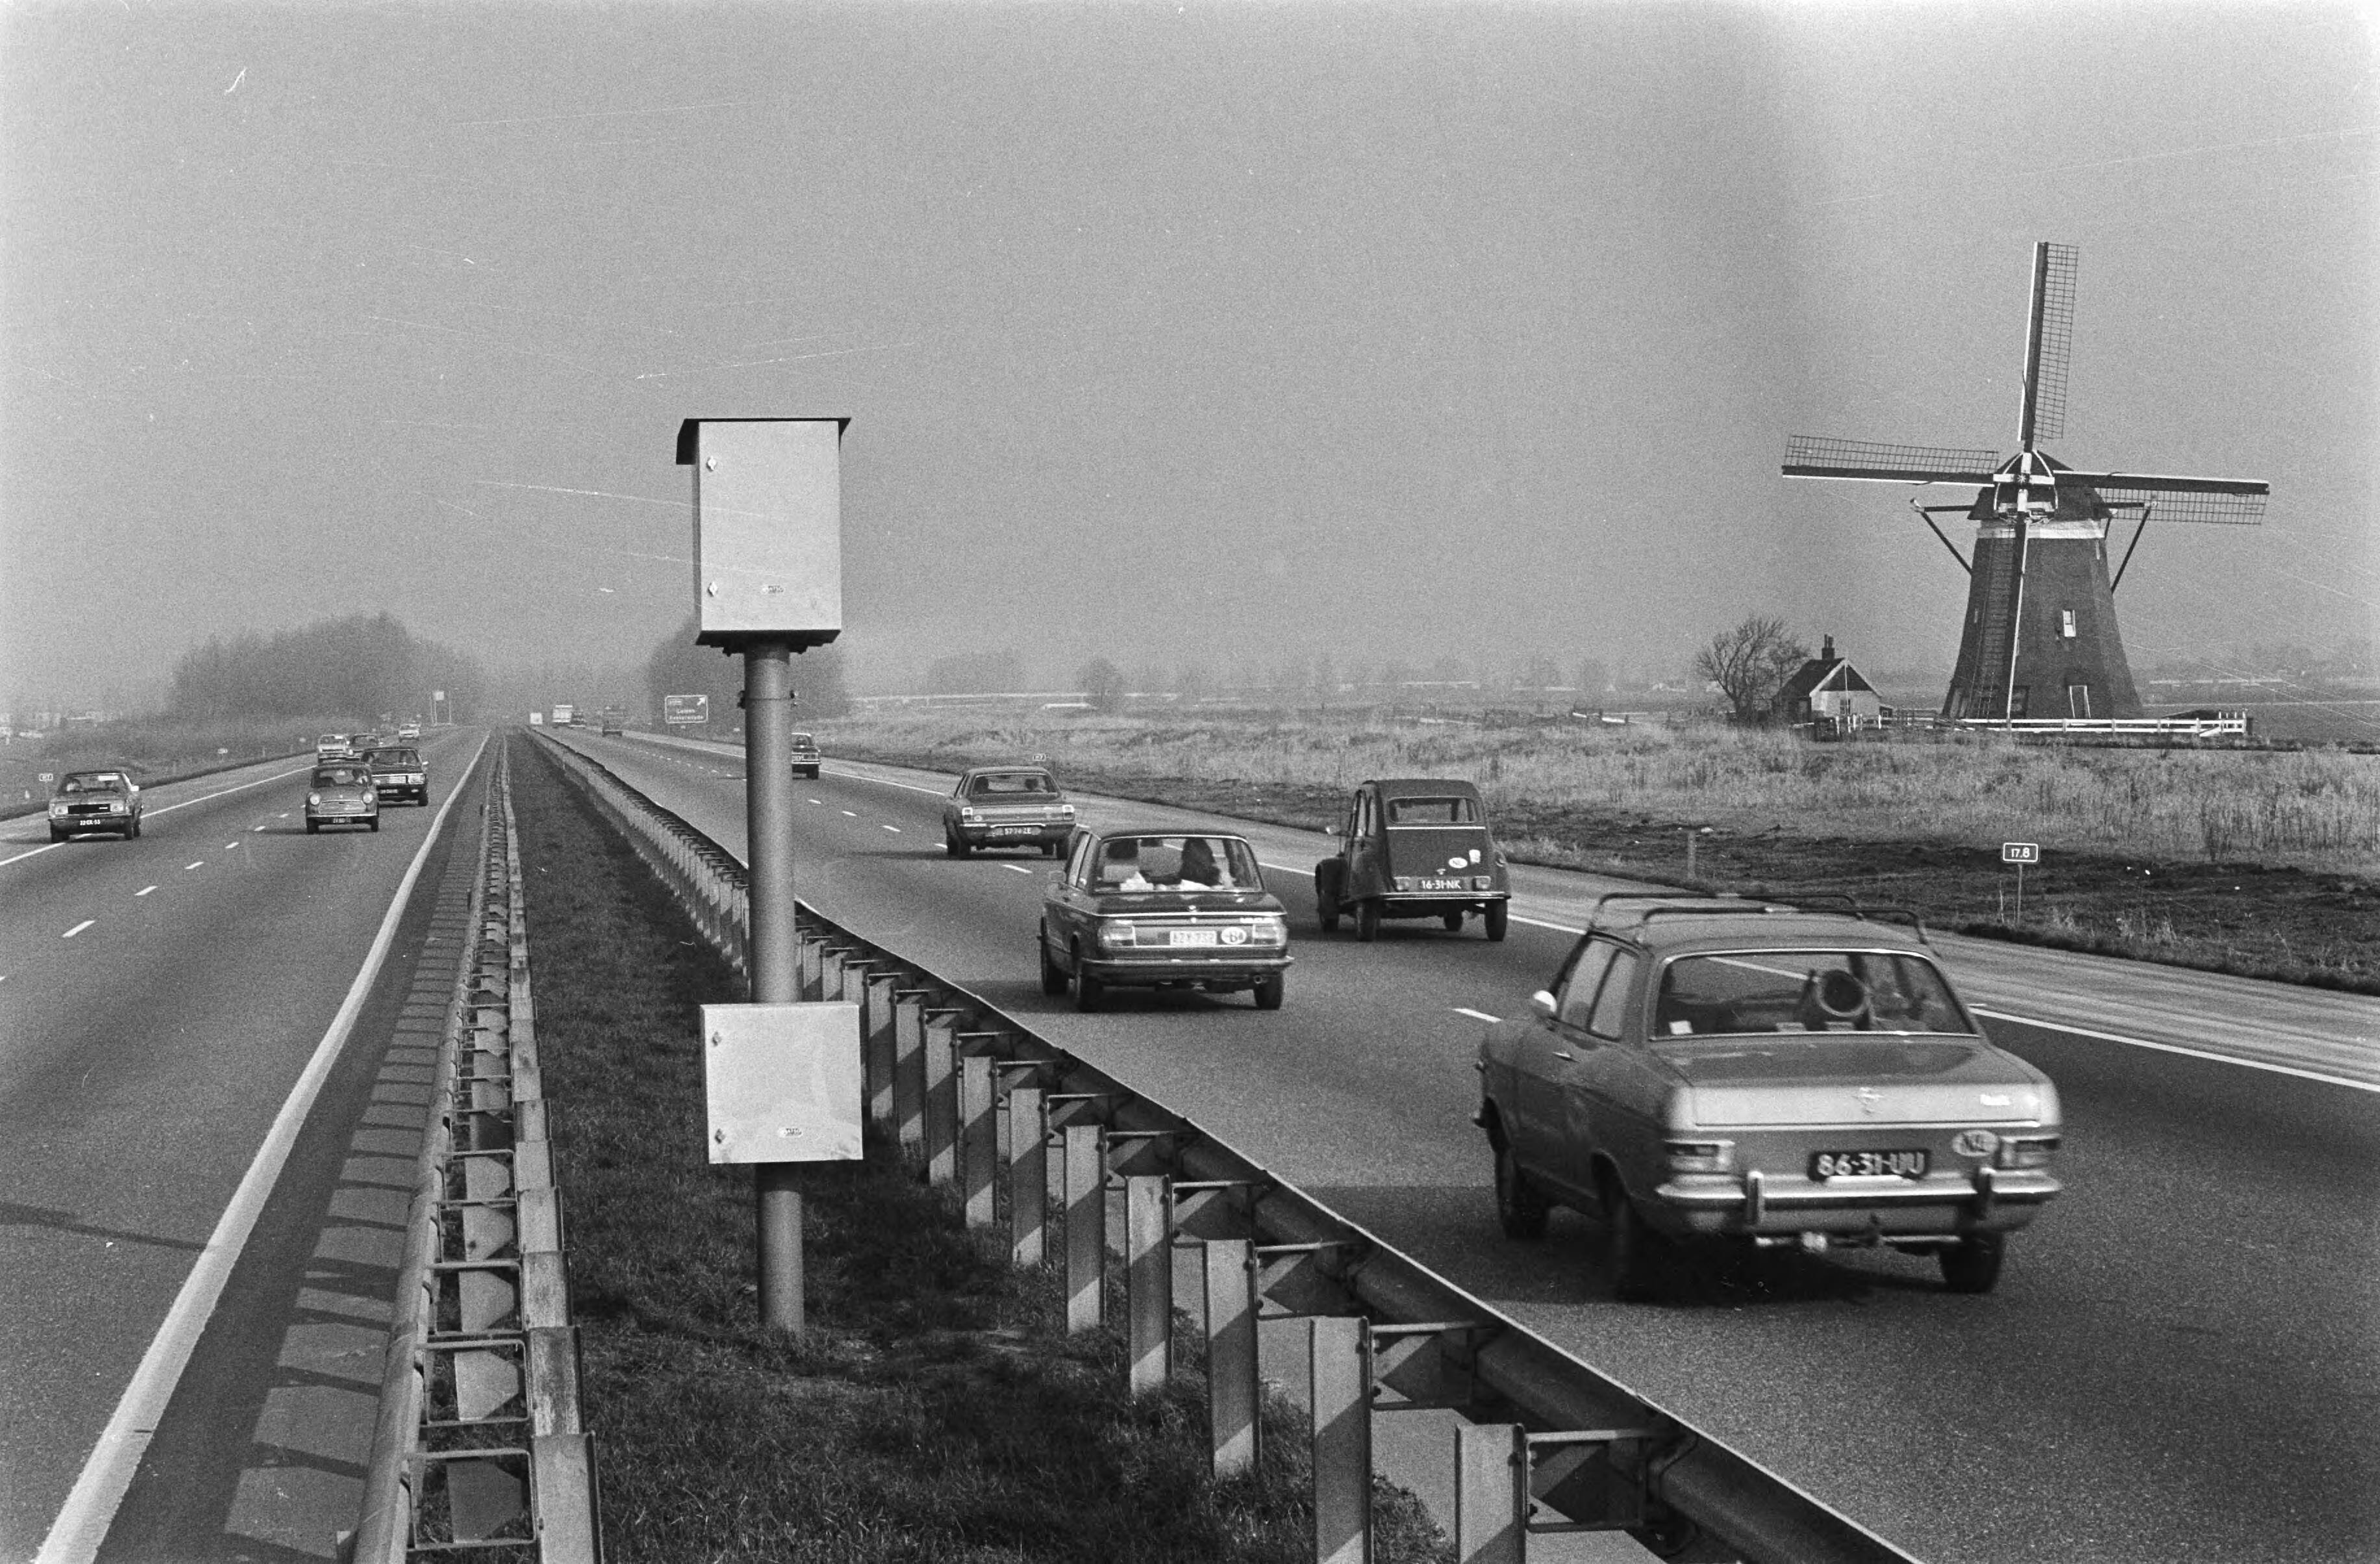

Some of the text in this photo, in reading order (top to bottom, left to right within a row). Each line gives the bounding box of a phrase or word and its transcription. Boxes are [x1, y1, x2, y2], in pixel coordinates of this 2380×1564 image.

[2011, 847, 2030, 858] 17.8
[1421, 880, 1462, 889] 16-31-NK
[1818, 1152, 1925, 1176] 86-31-UU
